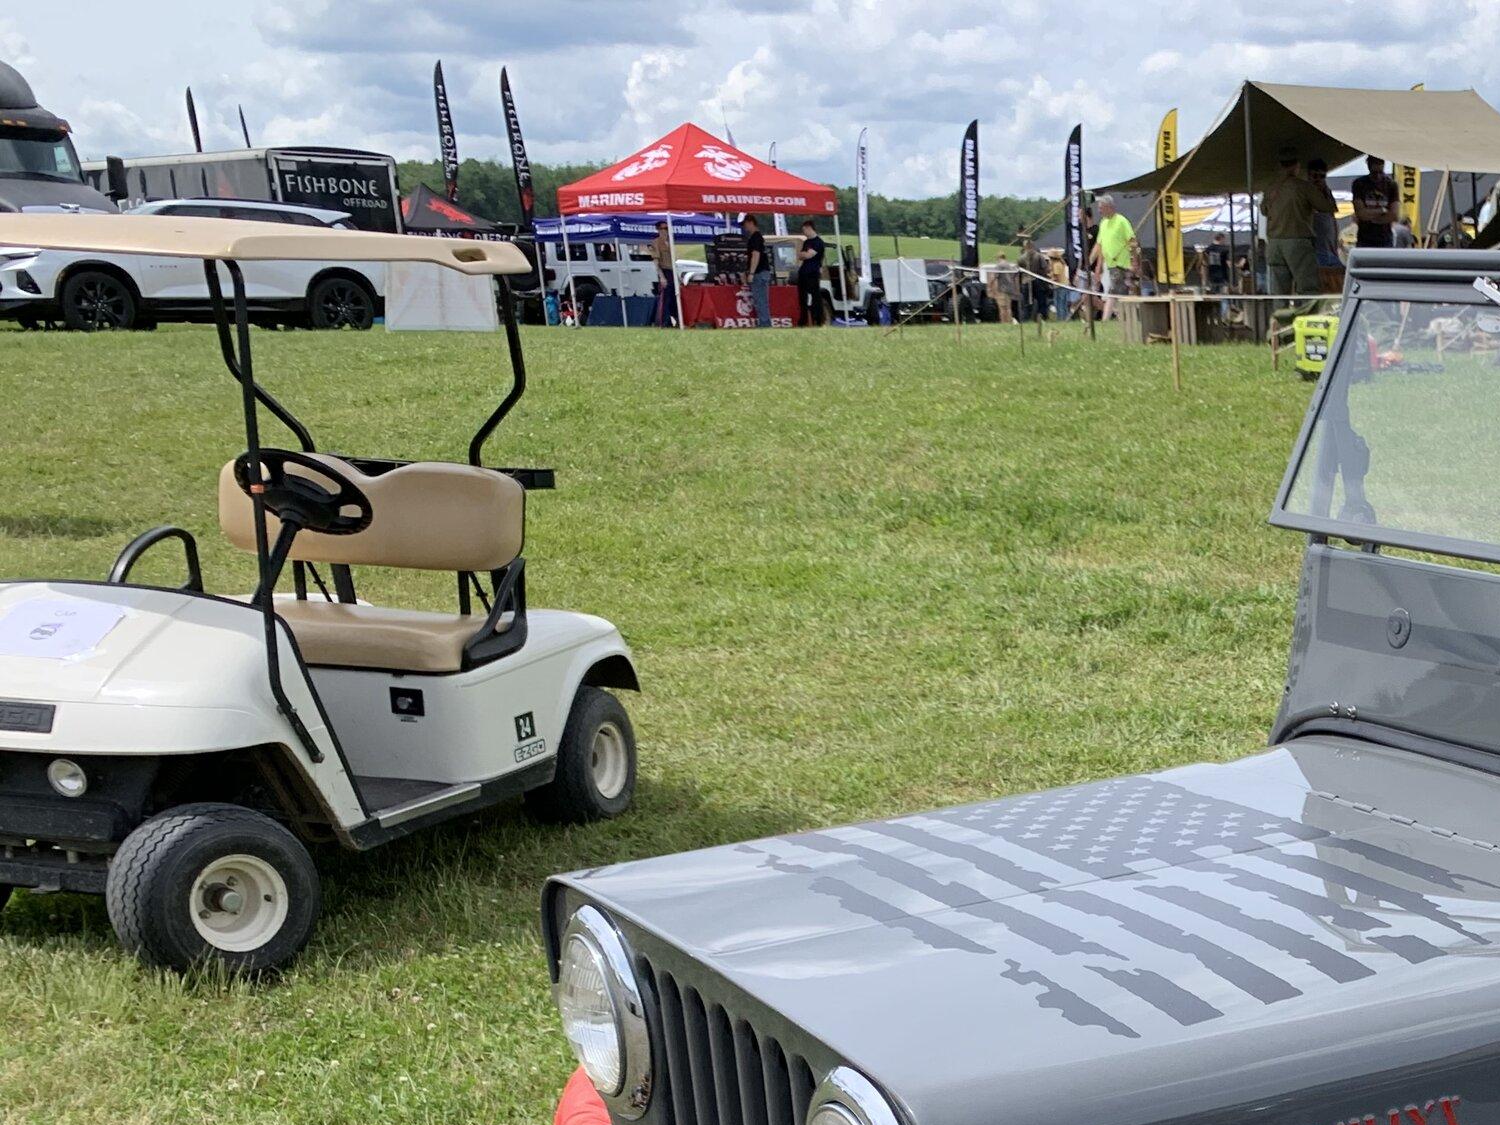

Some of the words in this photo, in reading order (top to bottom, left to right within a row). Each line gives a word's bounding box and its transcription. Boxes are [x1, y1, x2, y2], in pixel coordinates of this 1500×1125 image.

[284, 173, 380, 197] FISHBONE
[342, 198, 388, 209] OFFROAD
[578, 193, 645, 208] MARINES
[702, 194, 807, 206] MARINES.COM
